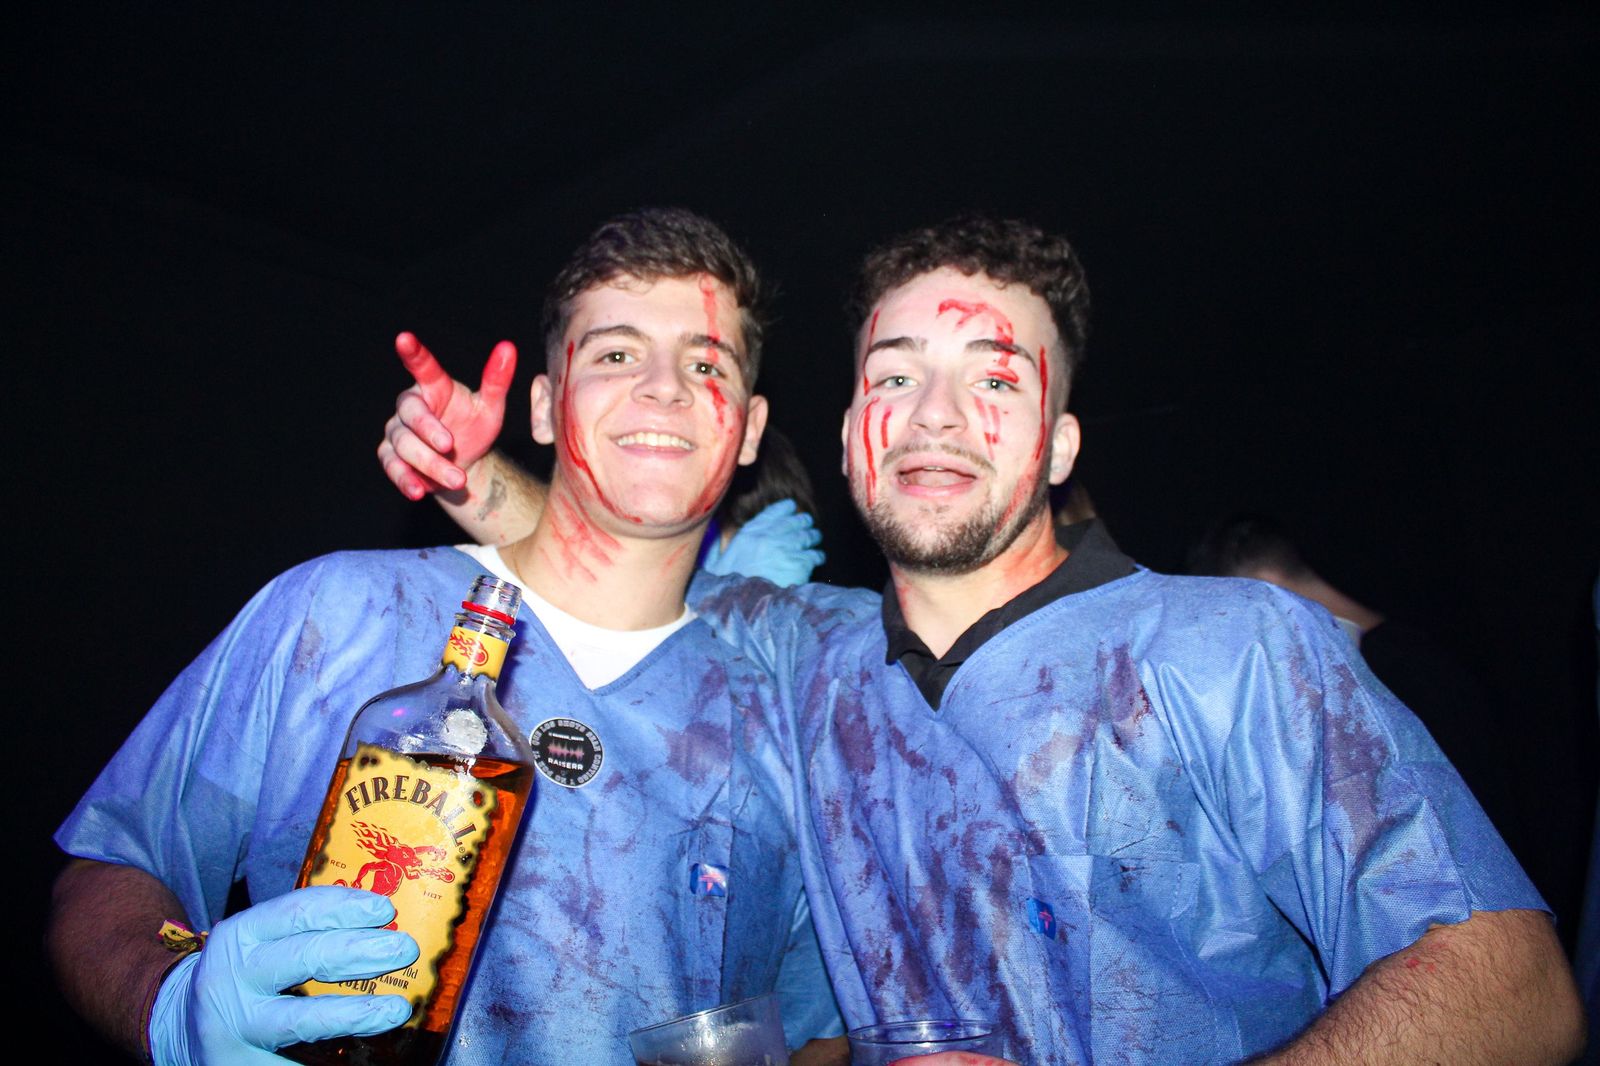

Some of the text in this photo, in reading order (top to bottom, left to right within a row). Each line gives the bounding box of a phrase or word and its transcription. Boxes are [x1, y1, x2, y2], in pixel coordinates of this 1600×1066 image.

[540, 721, 556, 732] LOS
[558, 720, 586, 732] SHOTS
[585, 731, 601, 752] SEAN
[538, 761, 554, 776] POR
[548, 758, 583, 770] RAISERR
[577, 754, 602, 783] CONTIGO
[555, 775, 567, 784] NO
[344, 774, 477, 847] FIREBALL
[329, 859, 347, 870] RED
[423, 890, 443, 900] HOT
